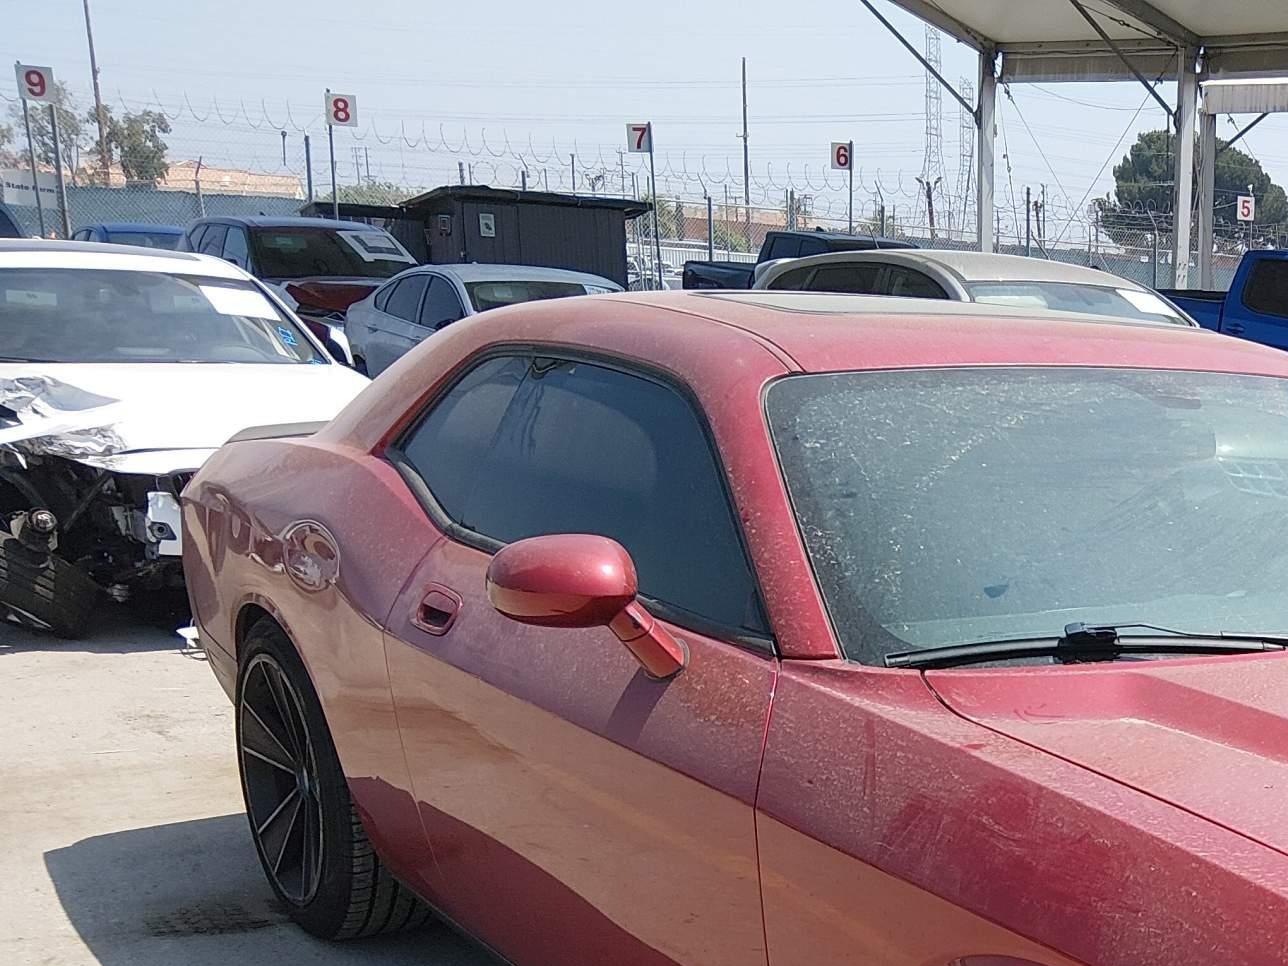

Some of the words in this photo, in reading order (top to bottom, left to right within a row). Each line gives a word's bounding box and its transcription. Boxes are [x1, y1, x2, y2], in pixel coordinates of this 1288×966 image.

[25, 70, 46, 97] 9
[333, 97, 350, 122] 8
[631, 127, 647, 149] 7
[836, 145, 848, 166] 6
[1241, 200, 1250, 217] 5
